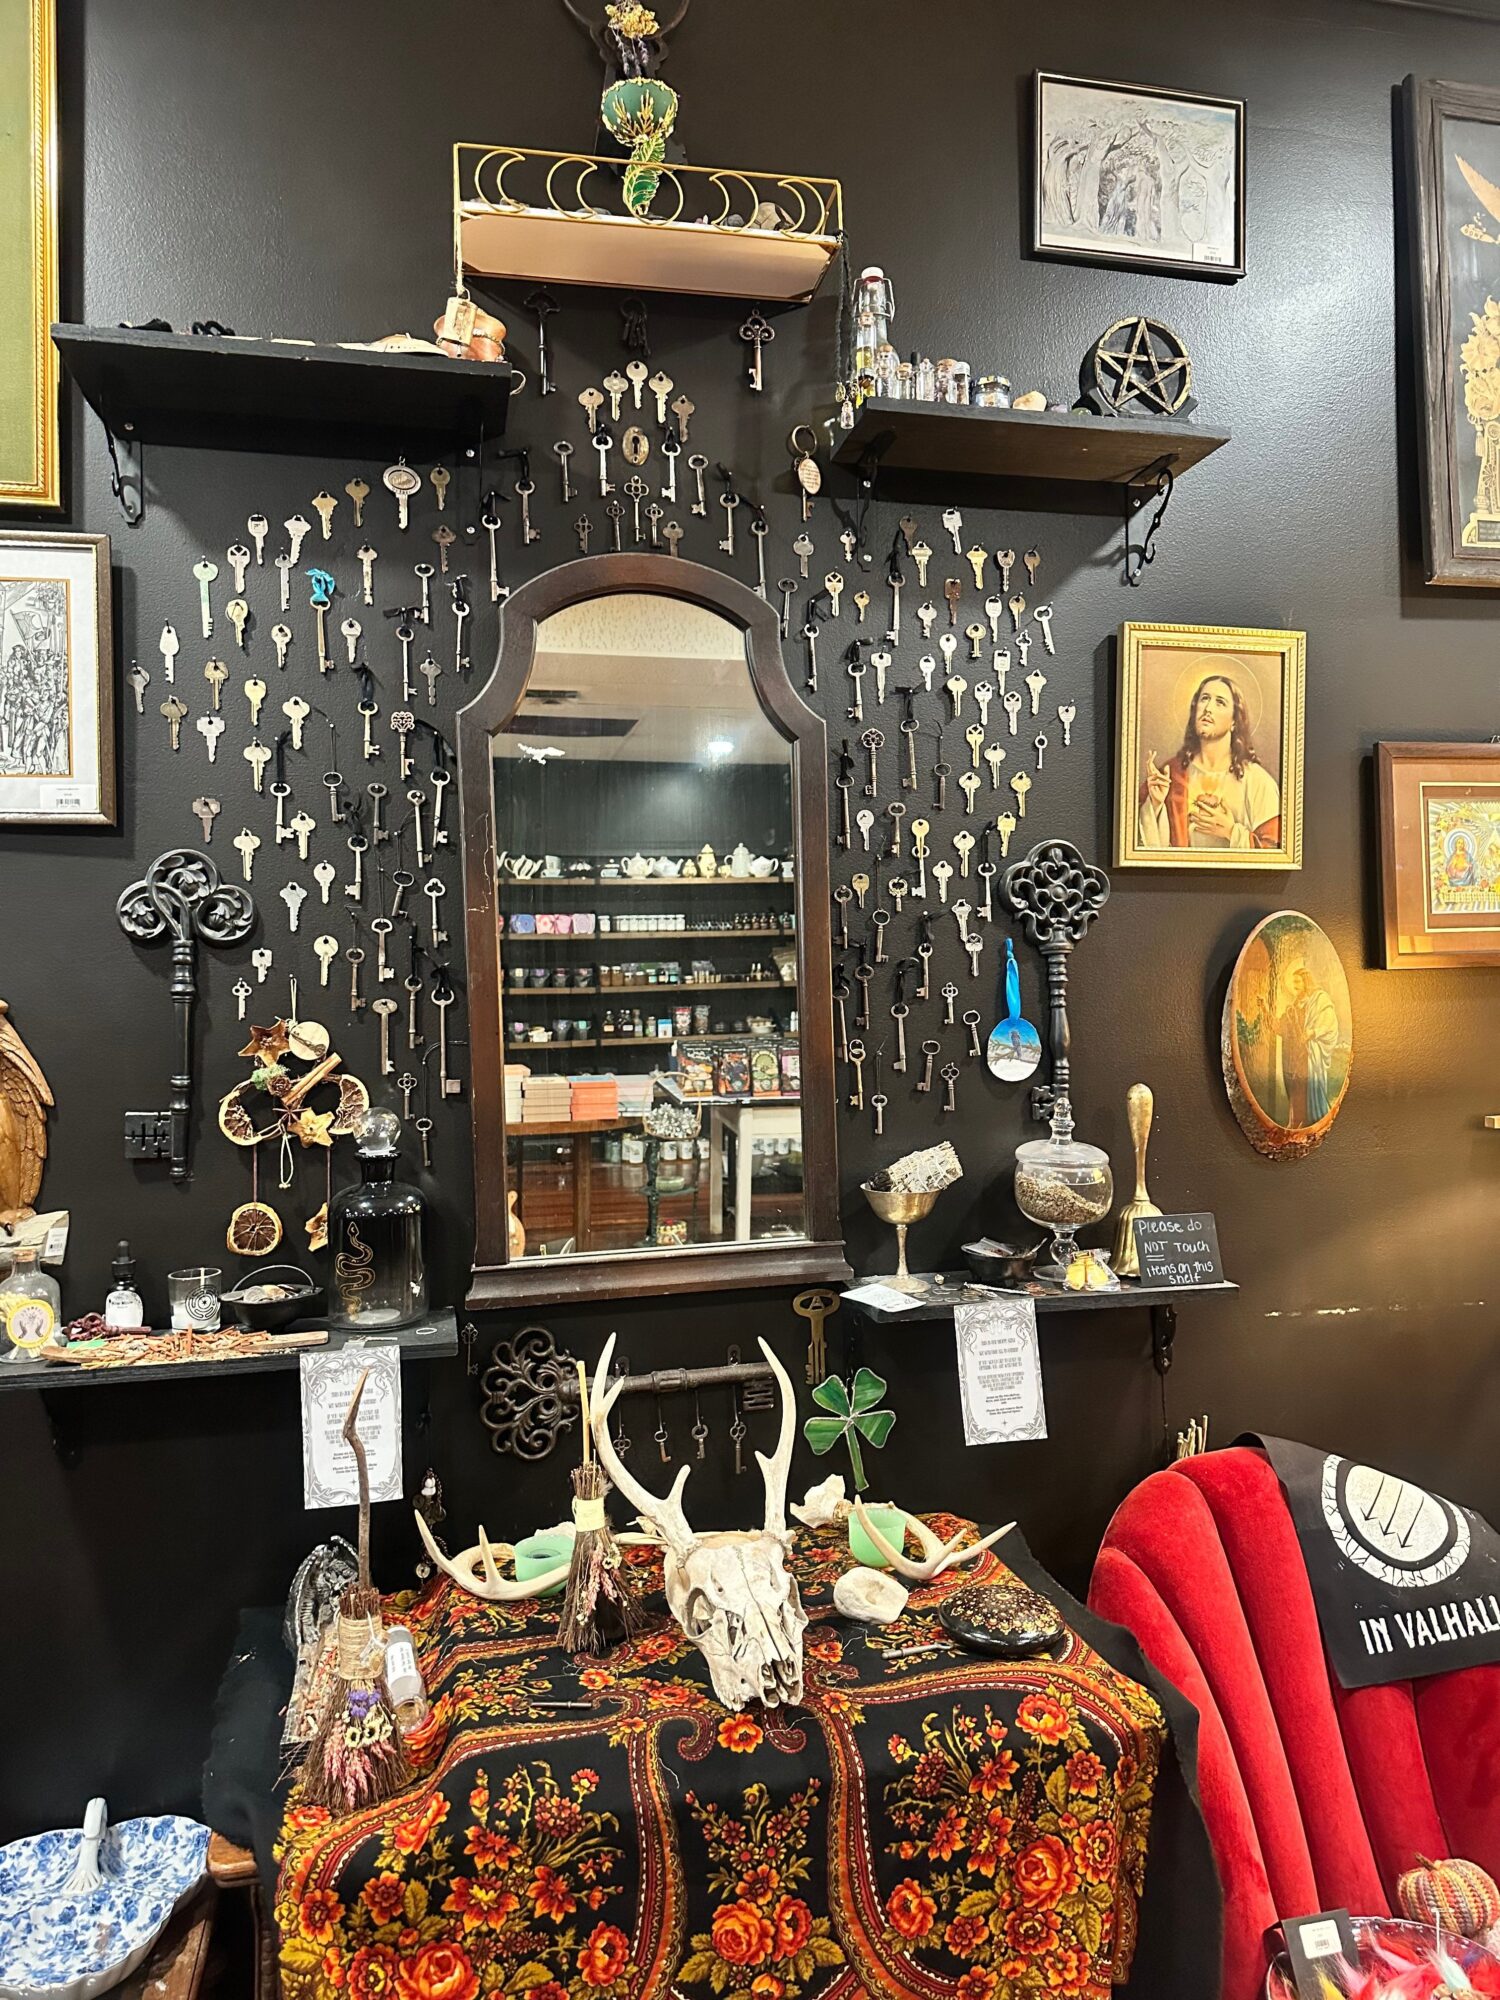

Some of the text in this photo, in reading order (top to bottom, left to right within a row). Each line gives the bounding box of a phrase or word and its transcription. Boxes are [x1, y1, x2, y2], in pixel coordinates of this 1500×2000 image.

[1138, 1218, 1202, 1236] Please do
[1144, 1240, 1168, 1254] NOT
[1177, 1263, 1190, 1274] on
[1169, 1273, 1202, 1284] shelf
[1359, 1617, 1394, 1655] IN
